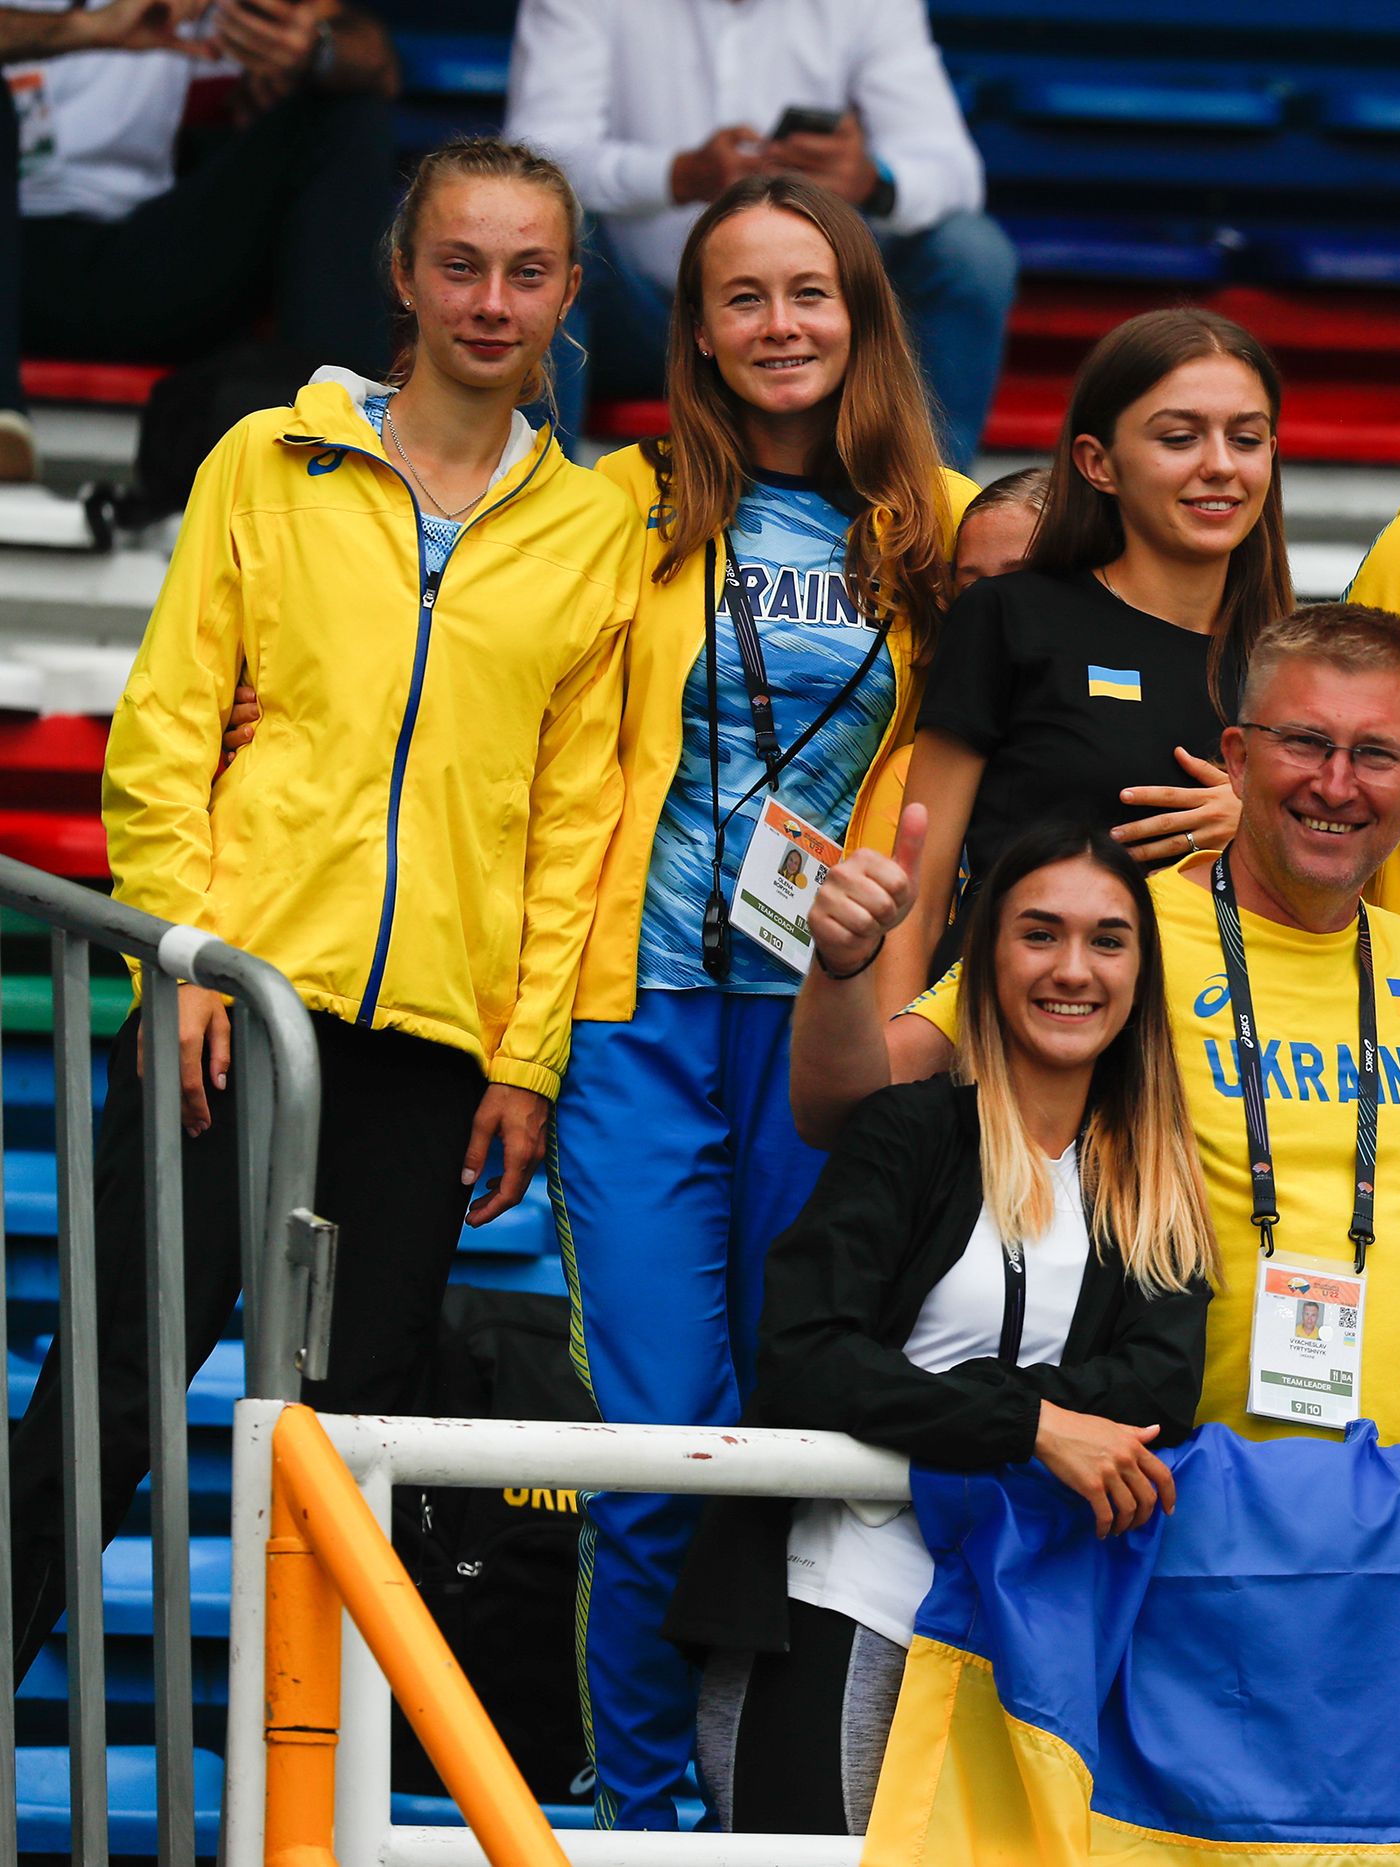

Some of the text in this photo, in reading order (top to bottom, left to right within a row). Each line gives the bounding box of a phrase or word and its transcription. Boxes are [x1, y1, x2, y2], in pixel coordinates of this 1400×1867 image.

[714, 563, 882, 632] RAIN
[757, 902, 795, 934] TEAM COACH
[762, 929, 782, 949] 9 10
[1239, 1014, 1251, 1039] asics
[1365, 1049, 1375, 1073] asics
[1281, 1376, 1332, 1391] TEAM LEADER
[1295, 1402, 1320, 1415] 9 10
